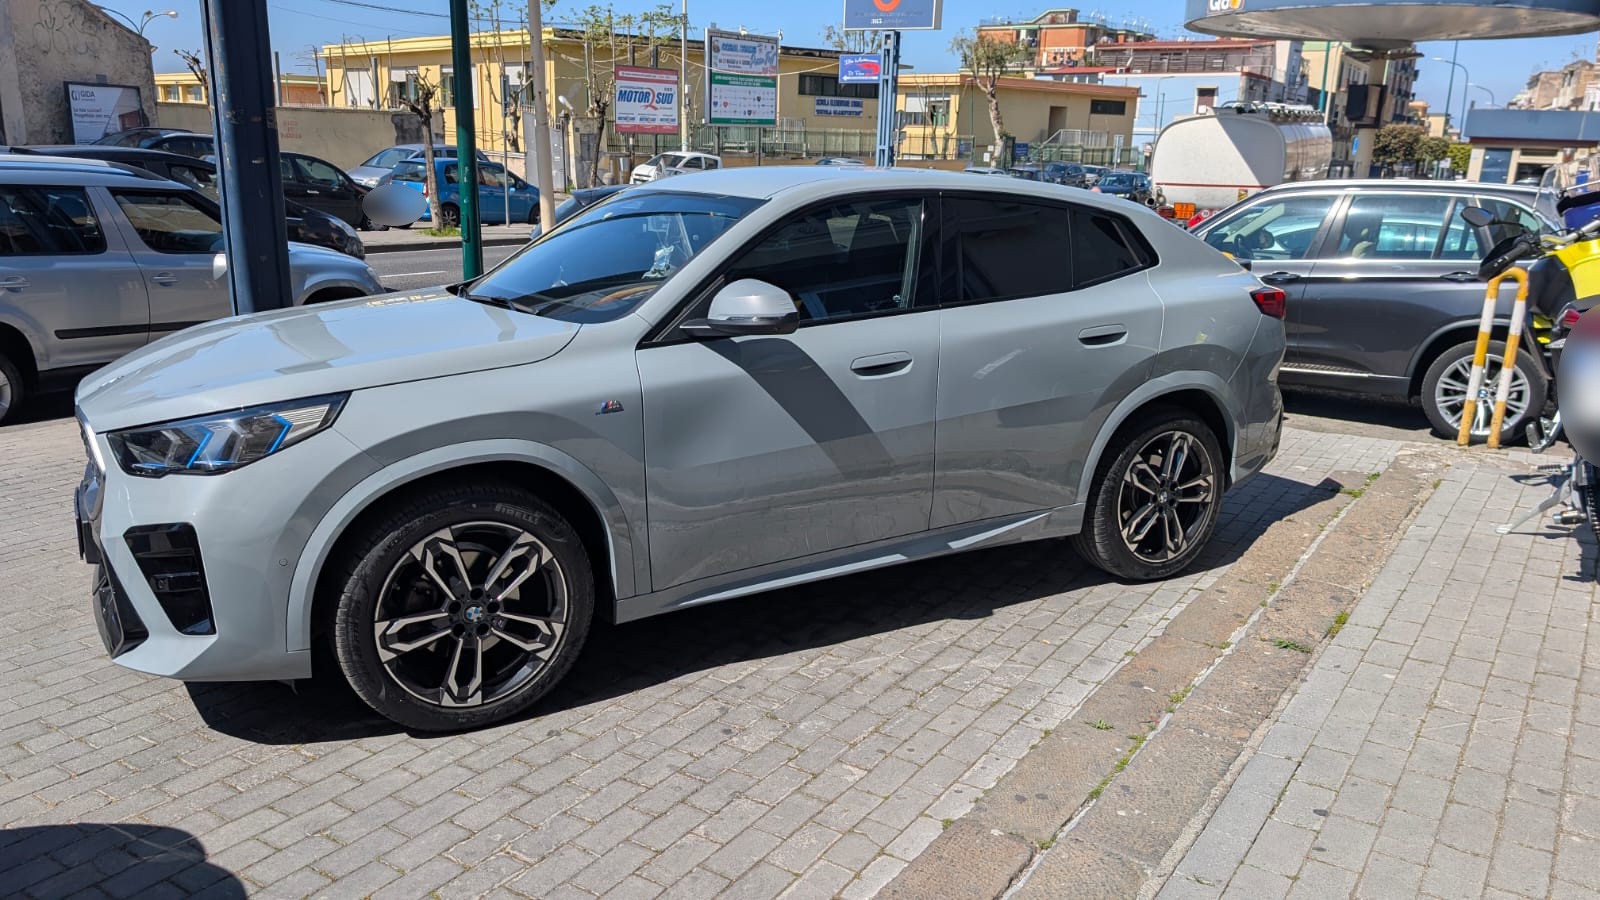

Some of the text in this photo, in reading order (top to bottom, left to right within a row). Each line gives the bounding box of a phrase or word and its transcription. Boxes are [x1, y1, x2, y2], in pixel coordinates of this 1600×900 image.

[80, 90, 96, 98] GIDA
[618, 89, 651, 104] MOTOR
[655, 92, 674, 105] SUD
[494, 502, 539, 525] PIRELLI
